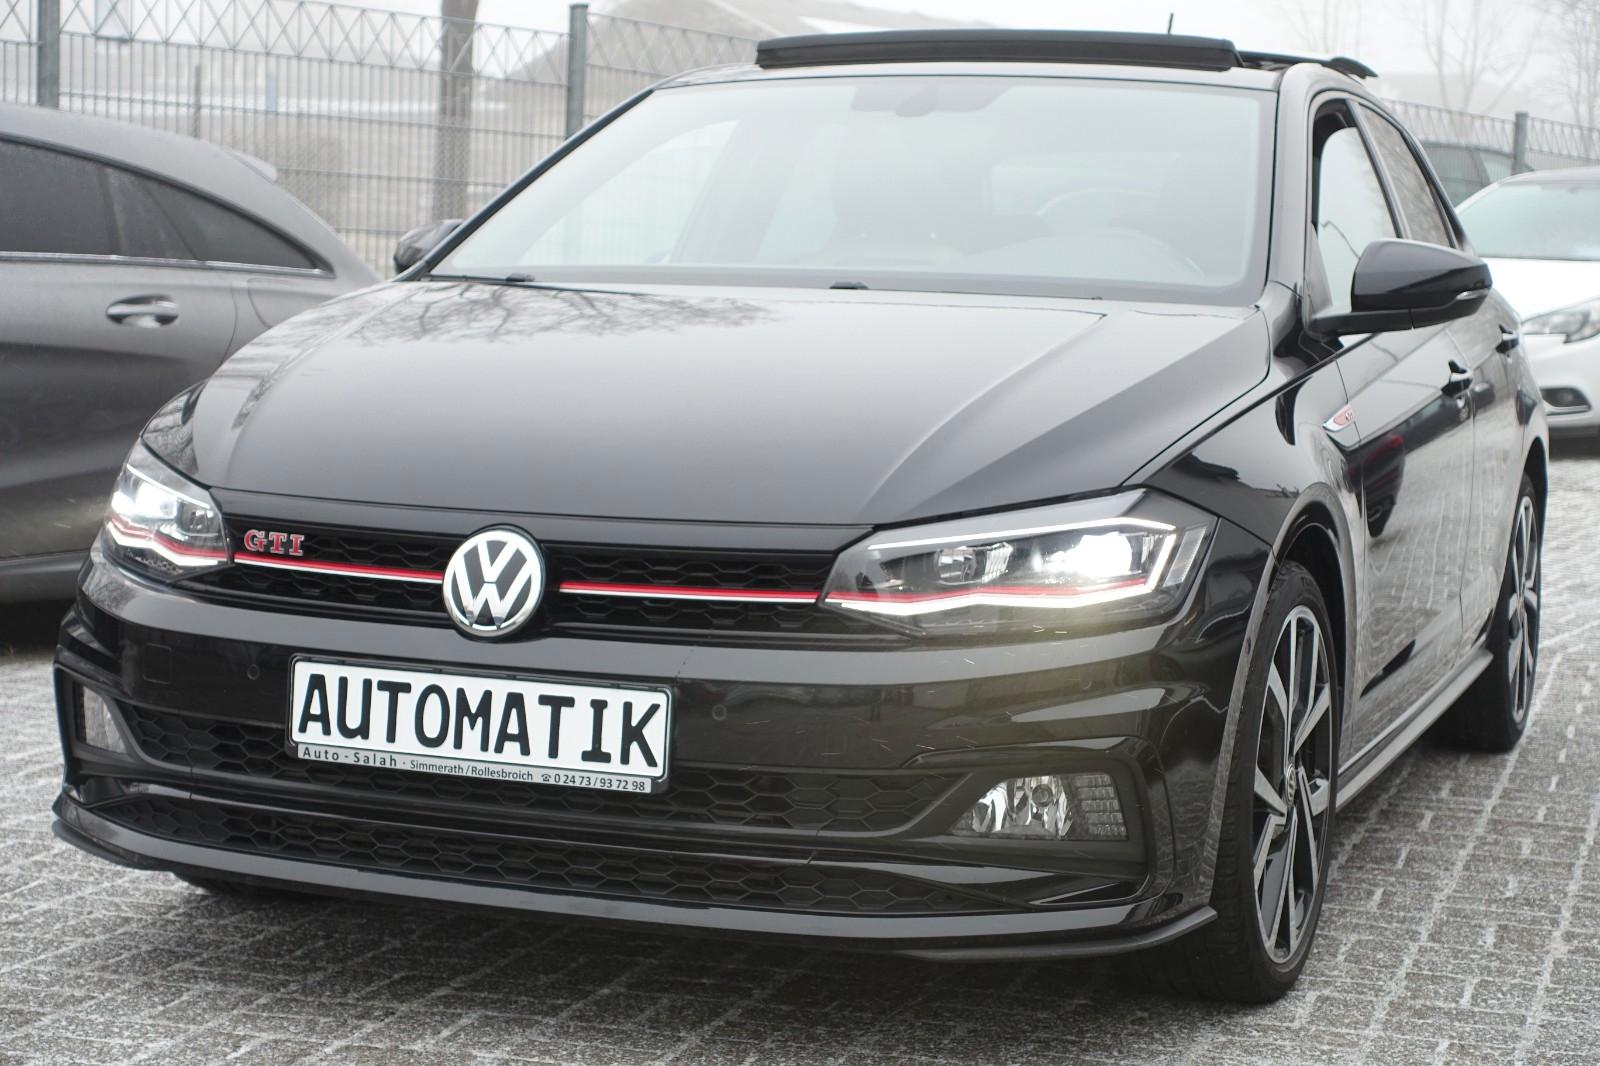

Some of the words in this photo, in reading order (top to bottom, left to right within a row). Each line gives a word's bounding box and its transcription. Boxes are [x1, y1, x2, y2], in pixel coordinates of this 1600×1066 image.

[244, 529, 304, 556] GTI
[298, 673, 661, 768] AUTOMATIK
[302, 747, 339, 761] Auto
[353, 752, 397, 767] Salah
